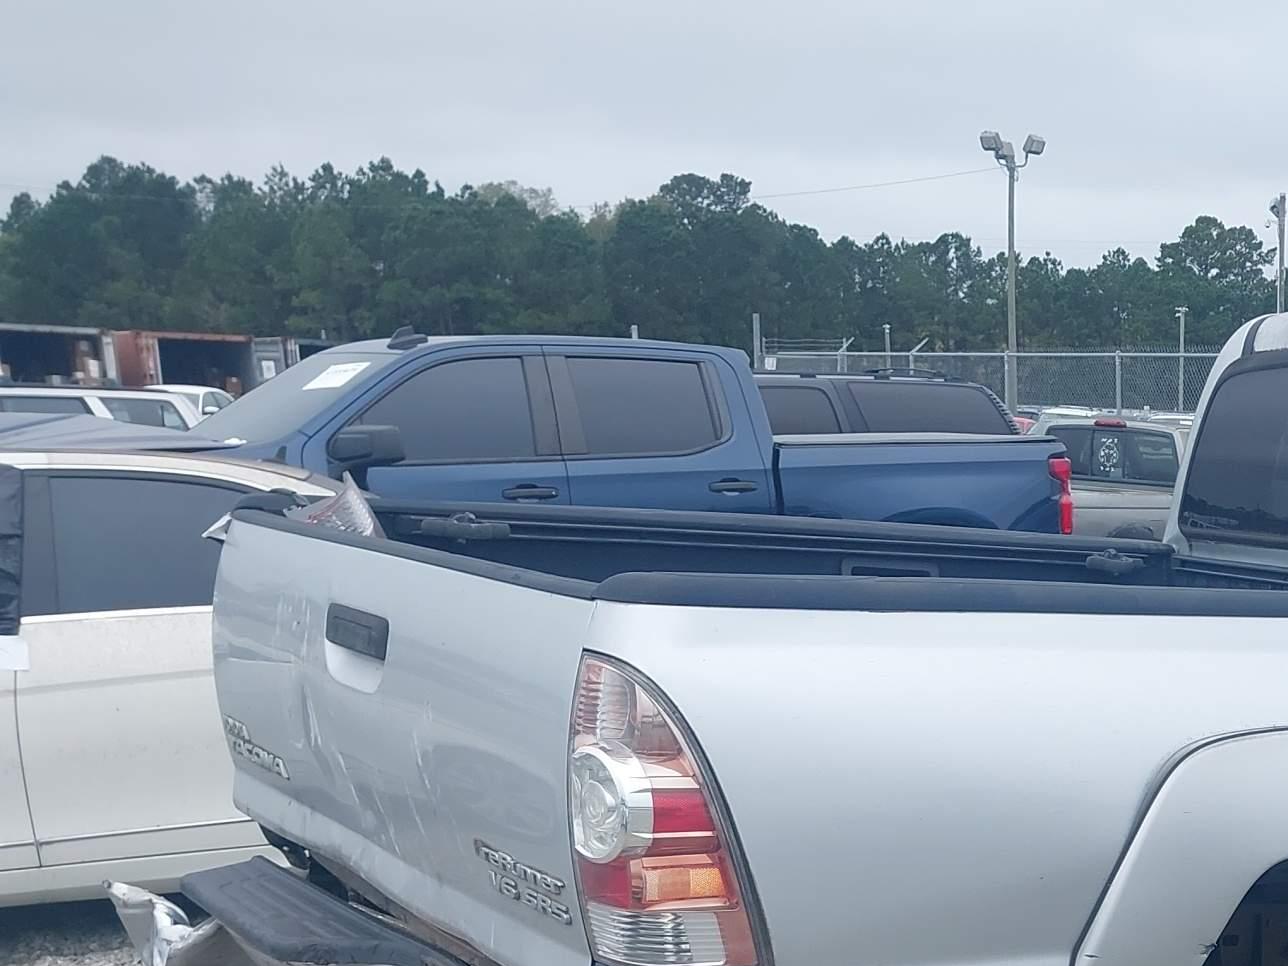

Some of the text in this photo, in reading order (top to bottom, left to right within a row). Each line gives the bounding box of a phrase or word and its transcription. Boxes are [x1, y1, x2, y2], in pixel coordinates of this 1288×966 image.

[231, 739, 289, 779] TACOMA
[488, 869, 573, 926] V6 SR5
